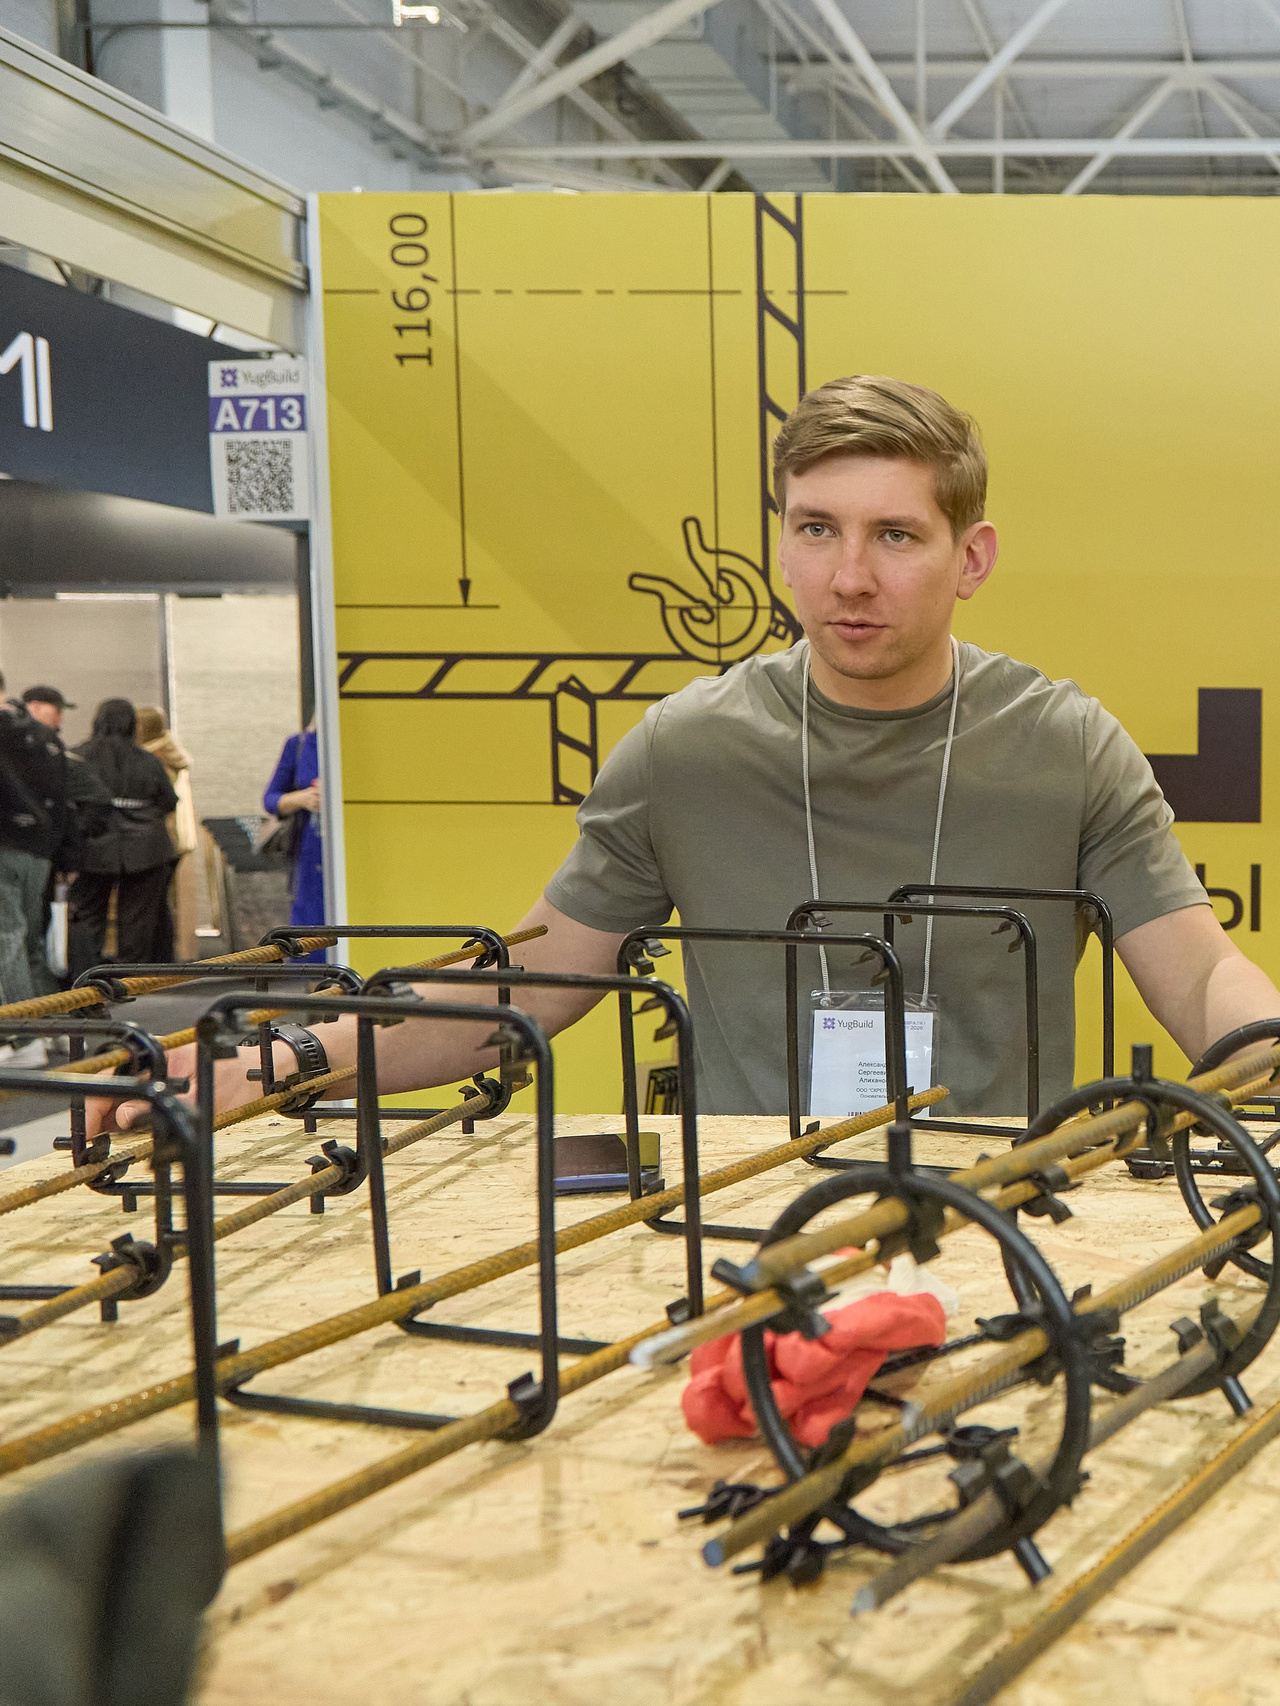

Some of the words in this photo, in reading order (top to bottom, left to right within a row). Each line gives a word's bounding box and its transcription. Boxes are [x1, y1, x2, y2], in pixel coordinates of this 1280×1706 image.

[389, 212, 439, 367] 116,00
[241, 369, 300, 387] YugBuild
[214, 398, 302, 431] A713
[837, 1019, 874, 1030] YugBuild
